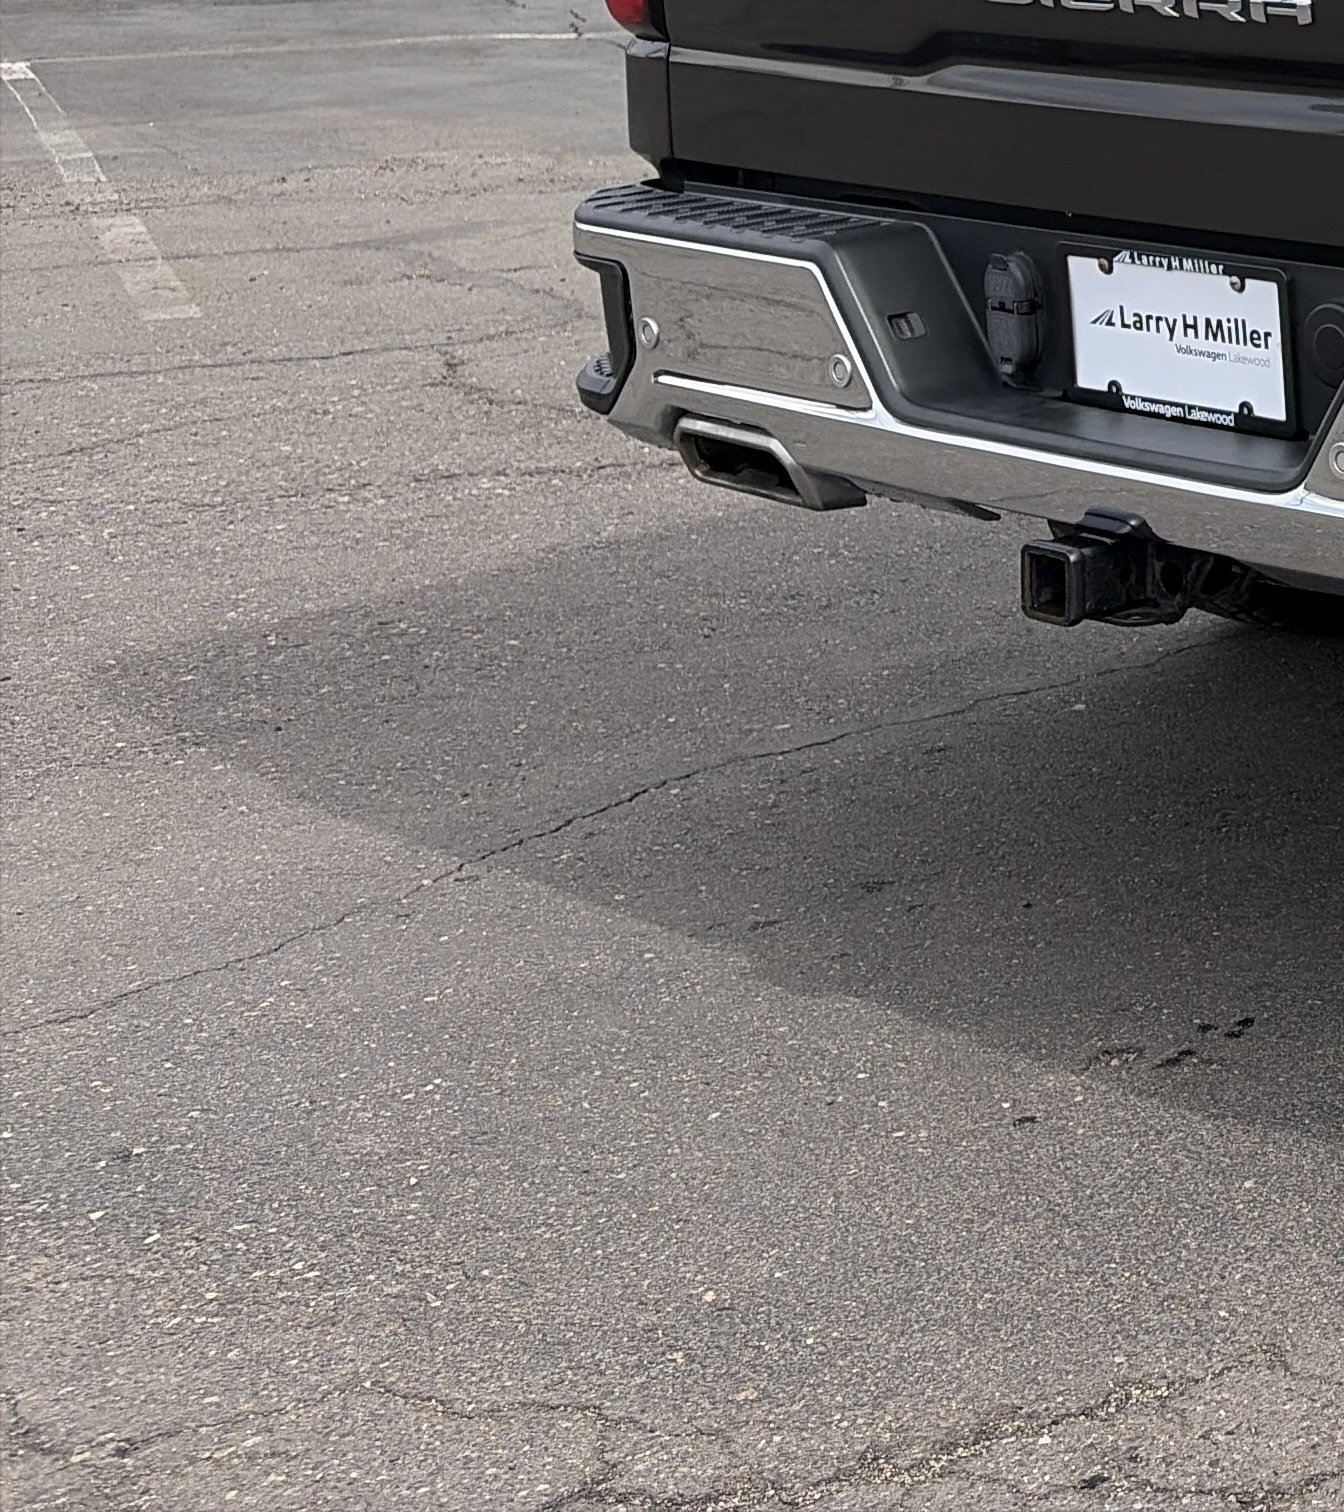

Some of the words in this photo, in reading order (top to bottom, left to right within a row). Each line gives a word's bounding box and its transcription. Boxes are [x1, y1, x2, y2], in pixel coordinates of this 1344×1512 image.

[1131, 251, 1169, 272] Larry
[1171, 255, 1181, 271] H
[1183, 258, 1226, 276] Miller
[1119, 305, 1178, 341] Larry
[1182, 313, 1199, 339] H
[1205, 317, 1273, 350] Miller
[1175, 343, 1227, 362] Volkswagen
[1228, 351, 1271, 368] Lakewood
[1122, 395, 1184, 418] Volkswagen
[1185, 405, 1235, 427] Lakewood
